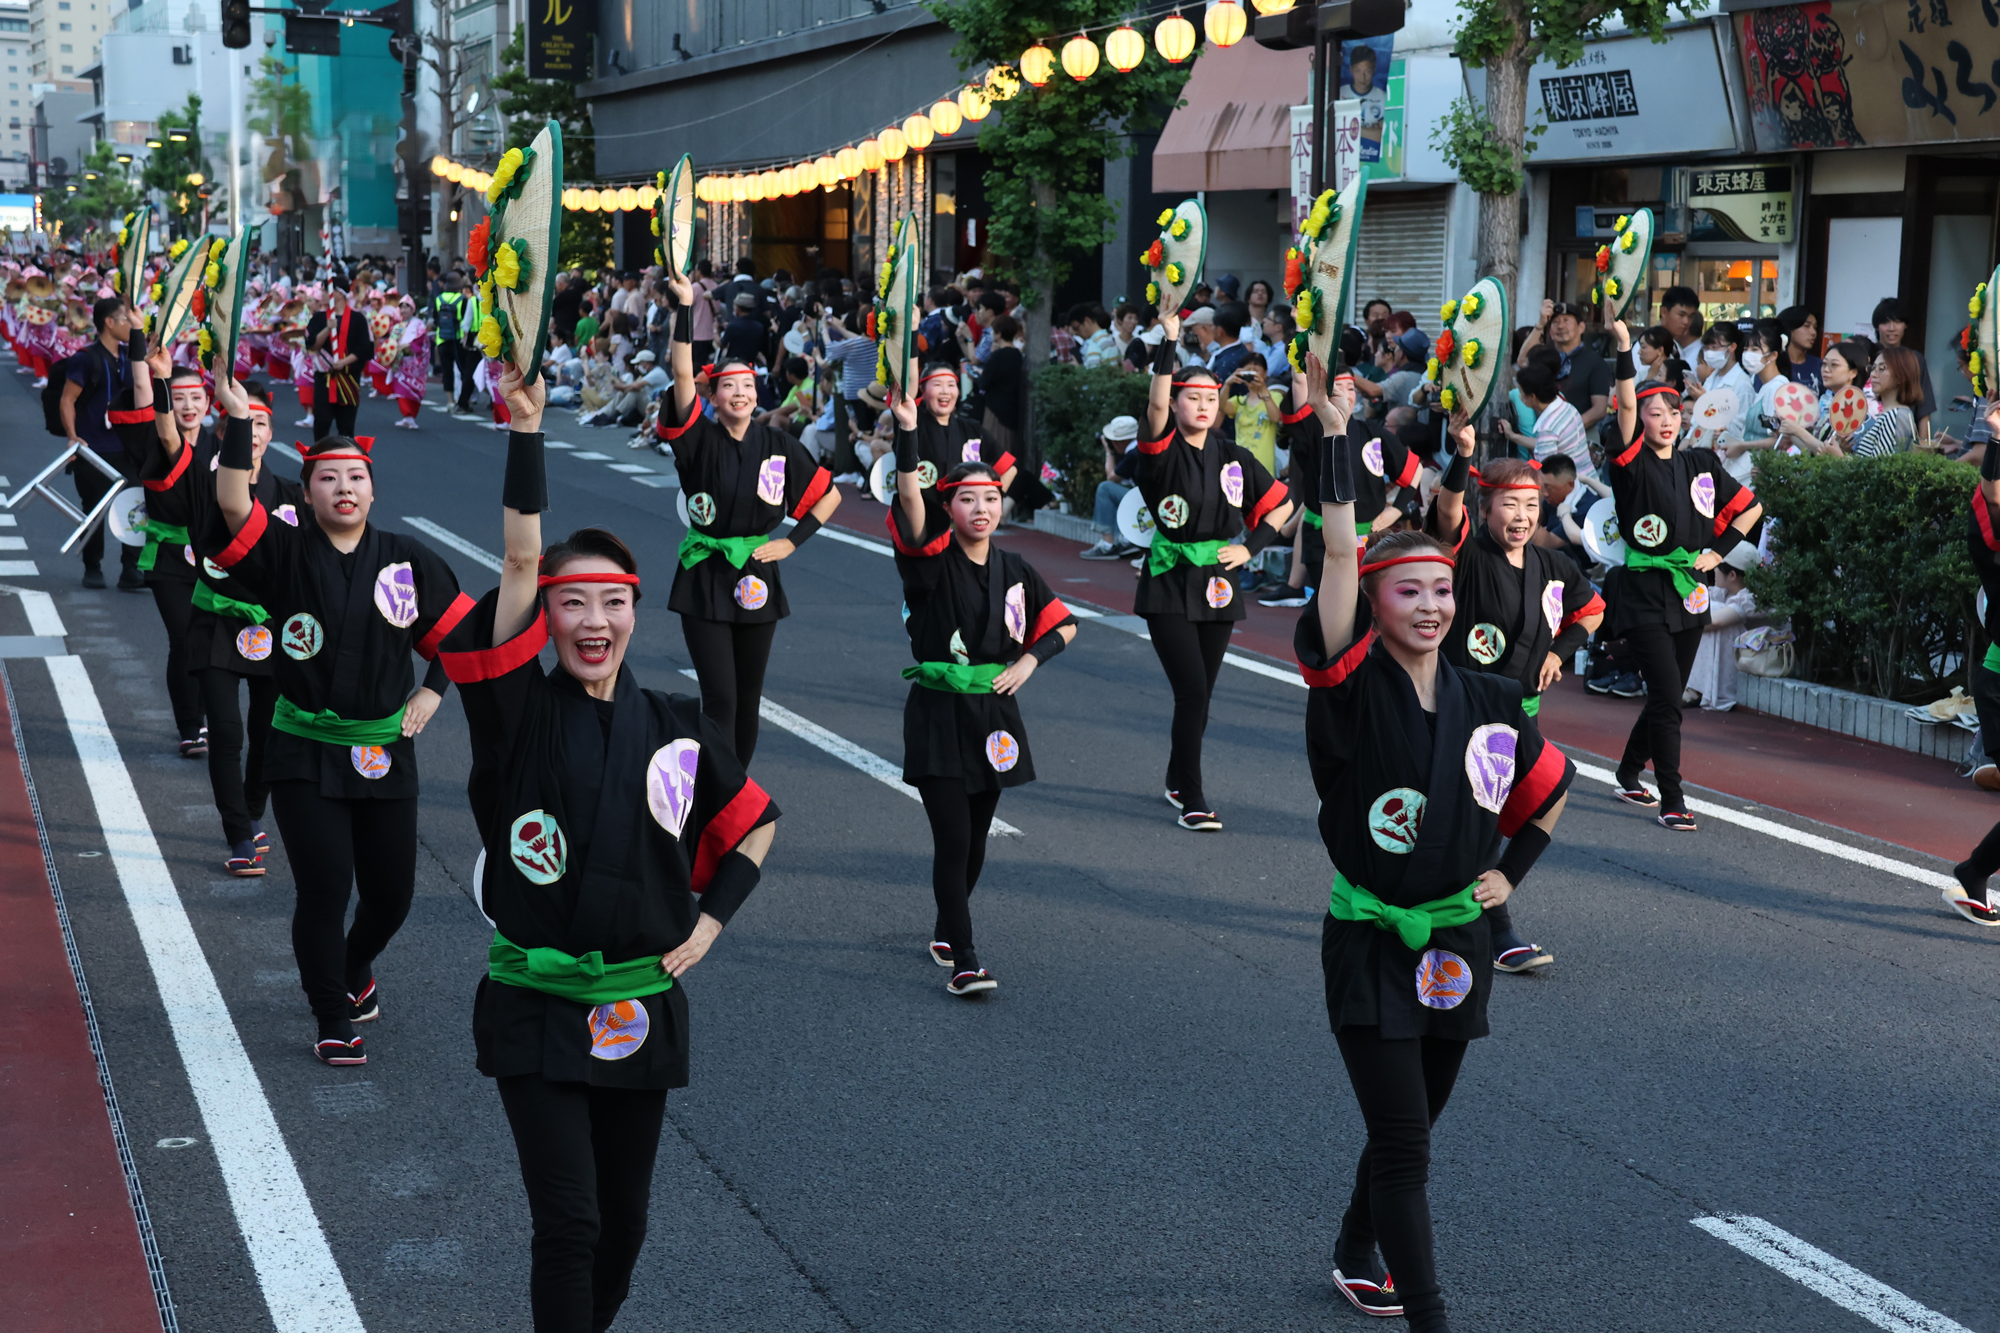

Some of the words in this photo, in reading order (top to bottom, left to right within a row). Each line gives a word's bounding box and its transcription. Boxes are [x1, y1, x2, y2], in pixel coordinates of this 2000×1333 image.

[1541, 73, 1636, 120] 東京蜂屋
[1696, 171, 1766, 194] 東京蜂屋
[1760, 213, 1787, 224] メガネ
[1761, 225, 1786, 237] 宝石
